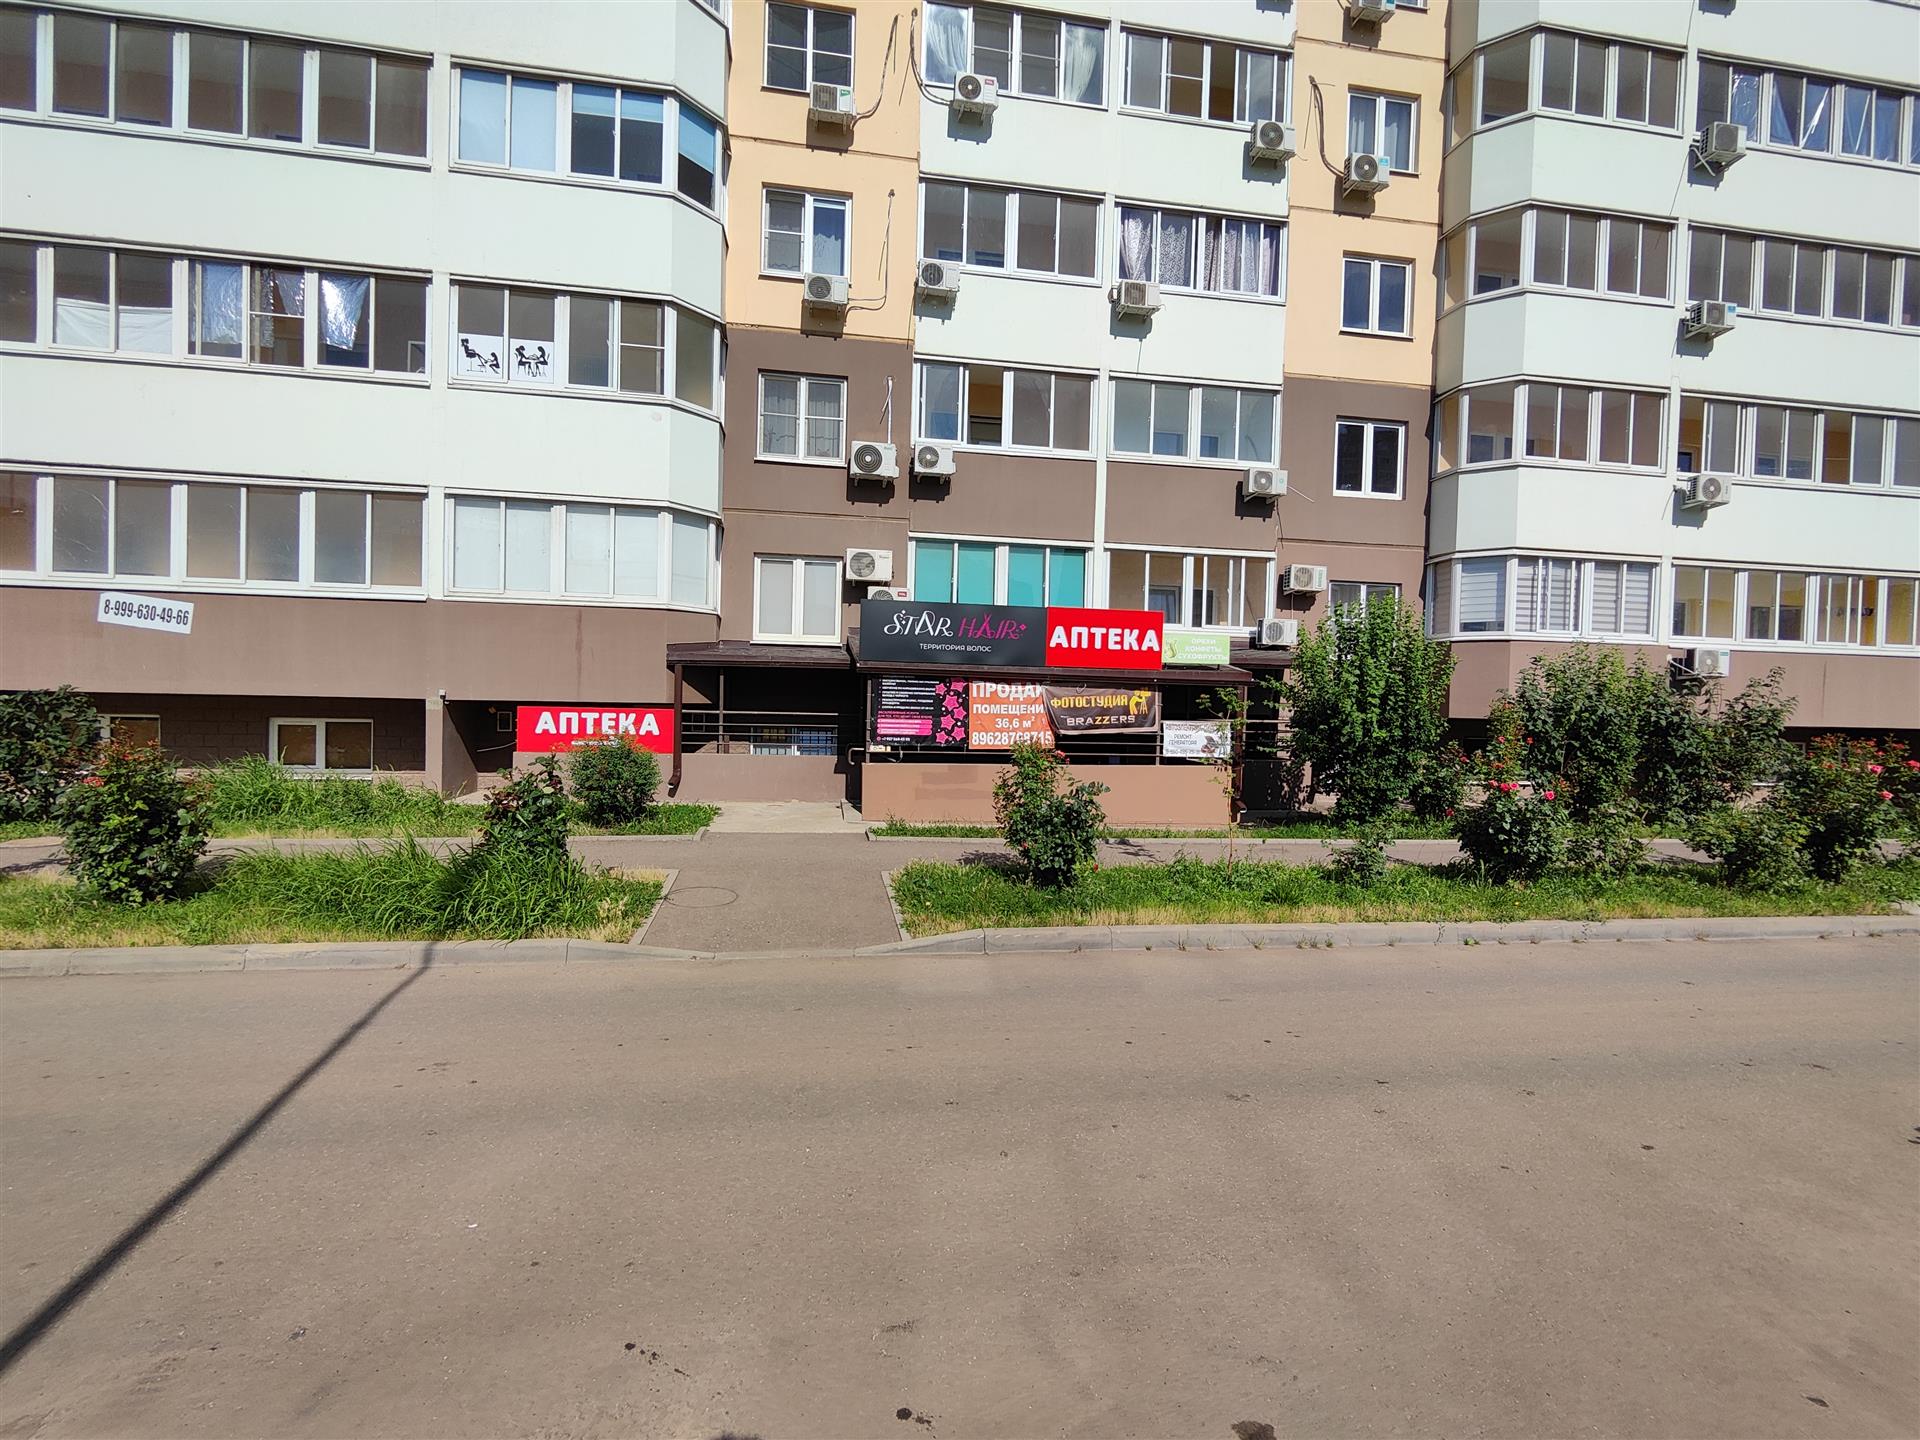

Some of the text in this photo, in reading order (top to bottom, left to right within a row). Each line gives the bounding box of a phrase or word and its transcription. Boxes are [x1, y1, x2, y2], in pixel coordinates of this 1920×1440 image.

[103, 599, 190, 626] 8-999-630-49-66
[883, 610, 1021, 640] STAR HAIR
[1049, 625, 1161, 652] АПТЕКА
[919, 643, 992, 653] ТЕРРИТОРИЯ ВОЛОС
[972, 681, 1042, 702] ПРОДА
[973, 703, 1044, 716] ПОМЕЩЕНИ
[1050, 694, 1128, 709] ФОТОСТУДИЯ
[534, 711, 660, 736] АПТЕКА
[995, 718, 1020, 730] 36,6
[1066, 715, 1136, 727] BRAZZERS
